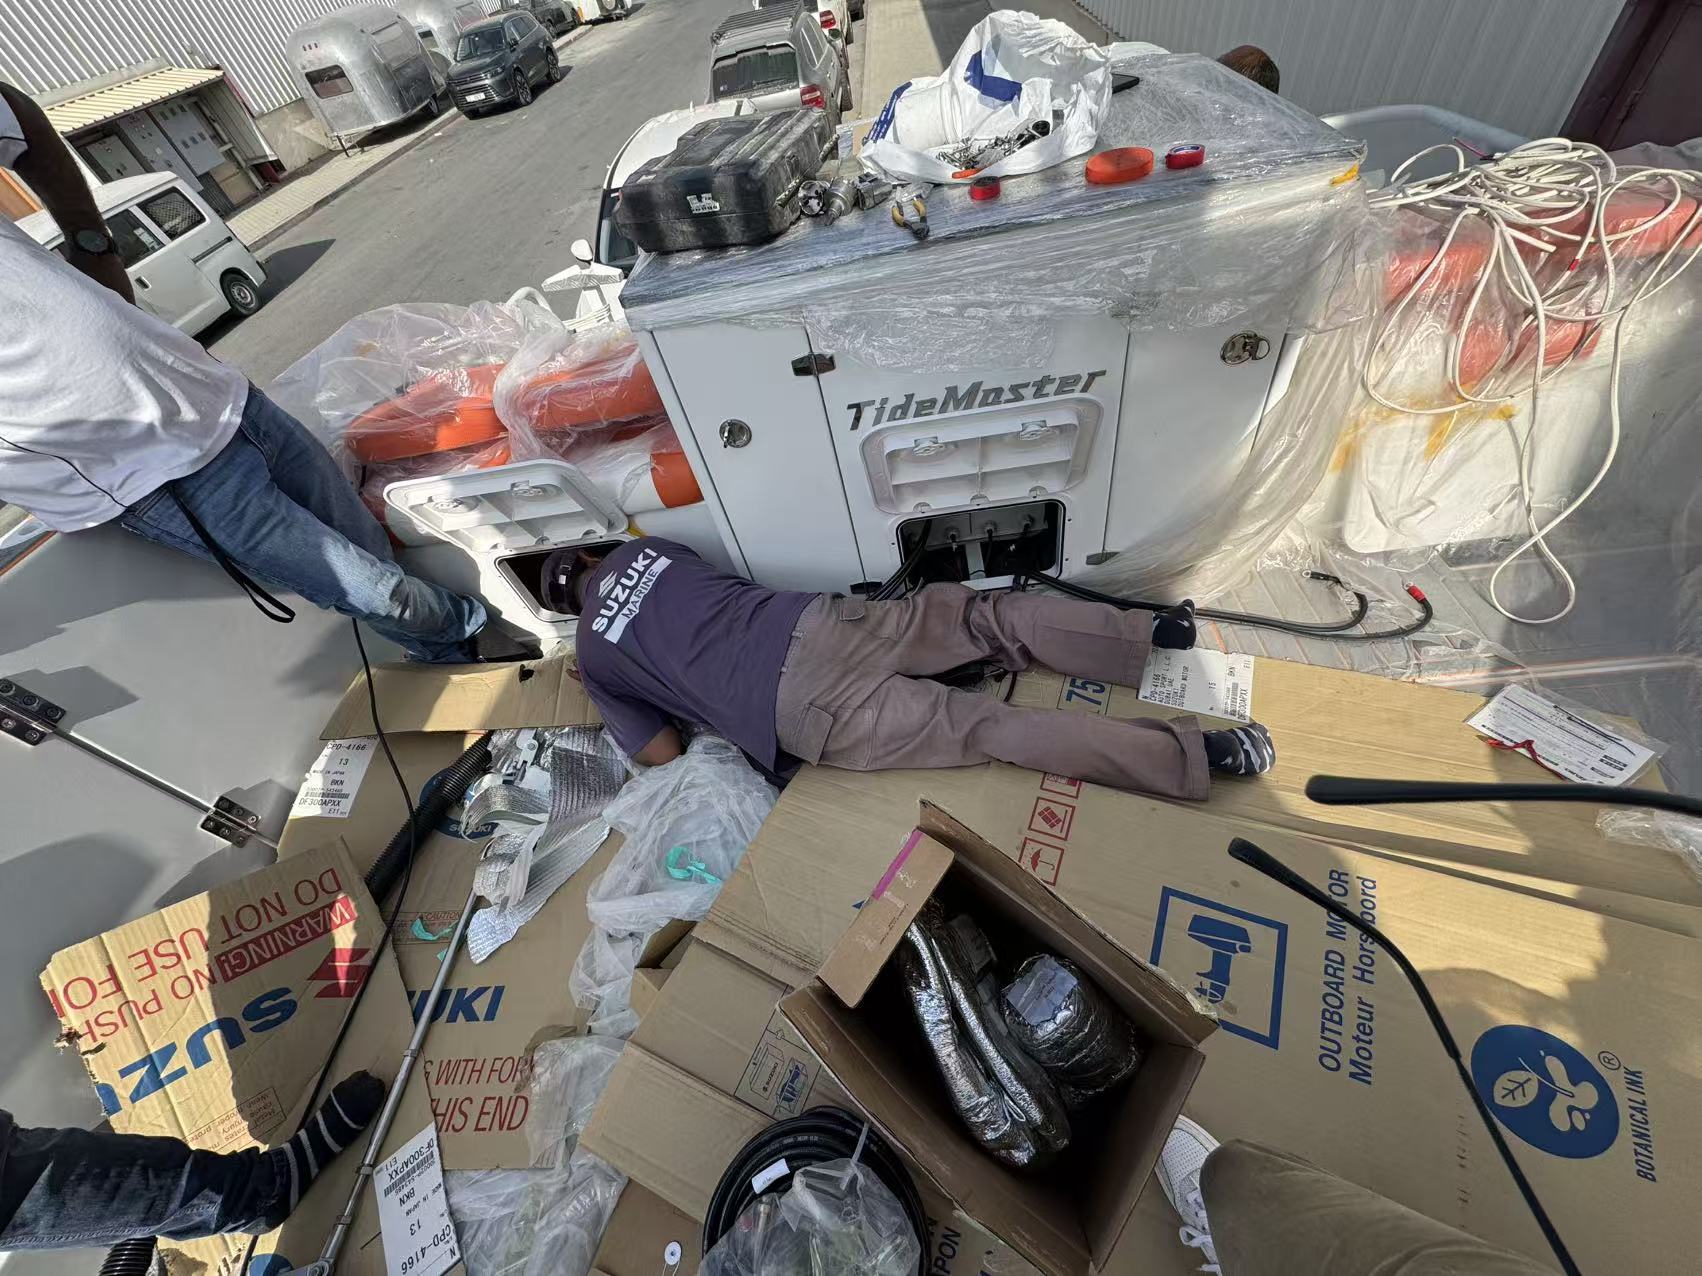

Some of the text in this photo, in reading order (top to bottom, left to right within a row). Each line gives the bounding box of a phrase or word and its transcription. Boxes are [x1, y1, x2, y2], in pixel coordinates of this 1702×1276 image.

[847, 369, 1107, 431] TideMaster
[592, 548, 657, 632] SUZUKI
[621, 568, 658, 619] MARINE
[1066, 678, 1105, 705] 75
[339, 758, 349, 766] 13
[299, 797, 343, 807] DF300APXX
[220, 867, 344, 945] DO NOT
[222, 901, 352, 979] WARNING!
[48, 927, 210, 1018] USE FO
[170, 964, 217, 1001] NO
[1318, 869, 1350, 1073] OUTBOARD MOR
[408, 985, 506, 1024] UKI
[1348, 996, 1375, 1086] Moteur
[435, 1058, 486, 1085] WITH
[474, 1095, 529, 1132] END
[1623, 1066, 1657, 1183] BOTANICAL INK
[388, 1137, 435, 1183] DF300APXX
[399, 1187, 416, 1207] BKN
[405, 1200, 421, 1216] JAPAN
[401, 1224, 451, 1275] CPD-4166
[410, 1218, 422, 1236] 13
[450, 1246, 456, 1260] N
[931, 1226, 961, 1276] PON
